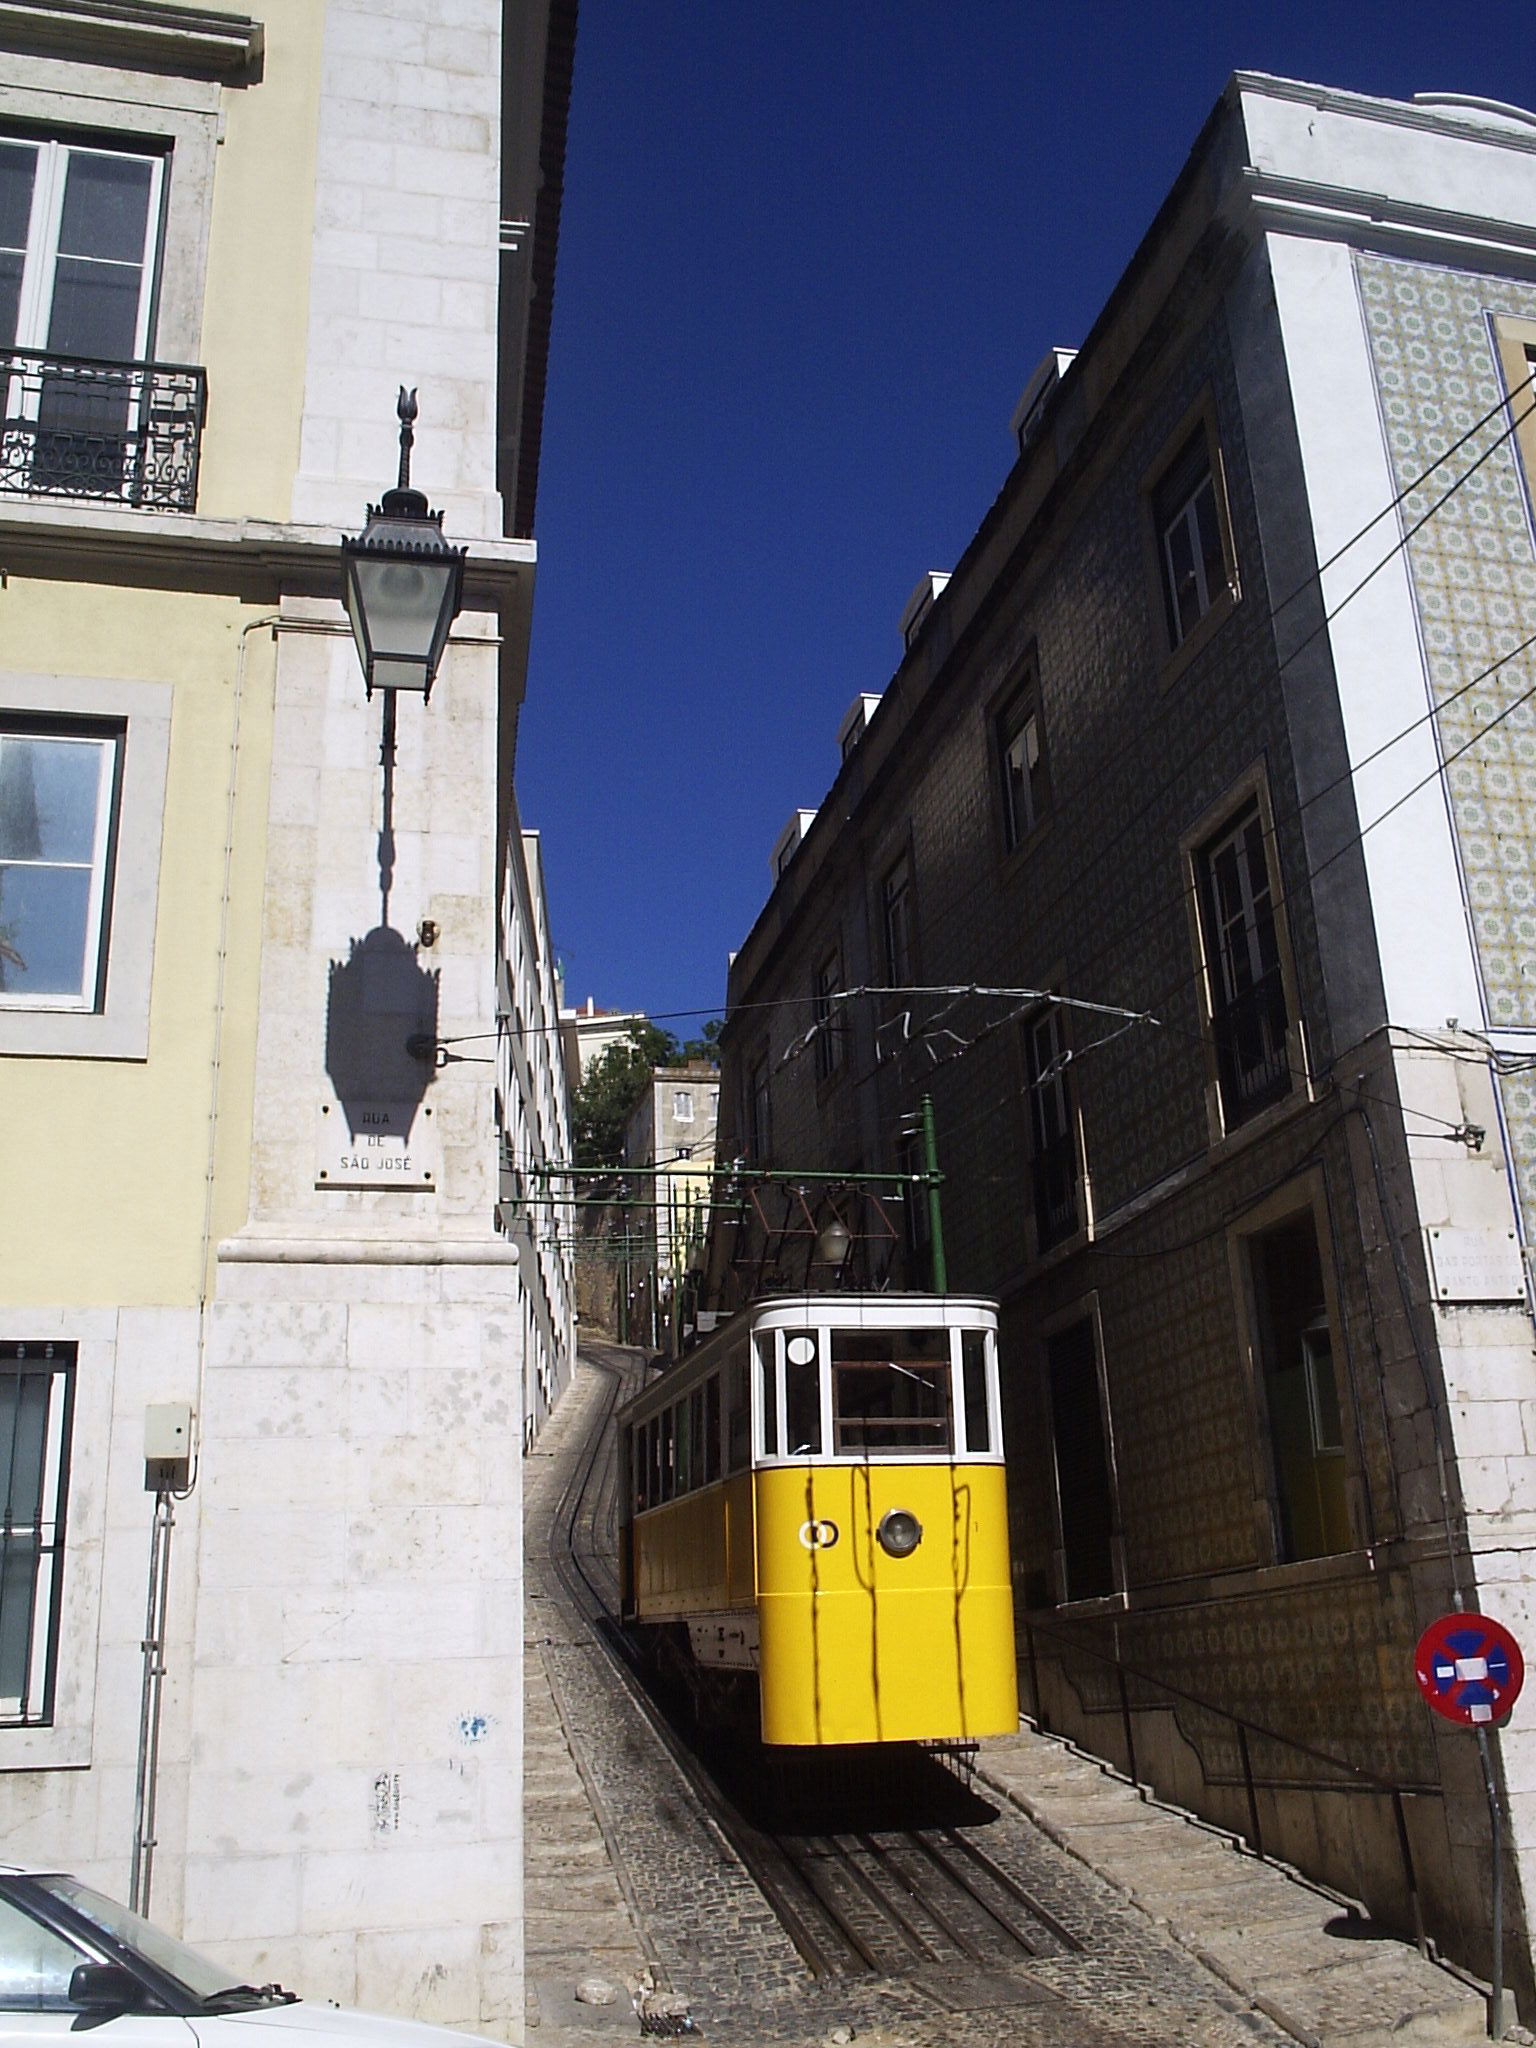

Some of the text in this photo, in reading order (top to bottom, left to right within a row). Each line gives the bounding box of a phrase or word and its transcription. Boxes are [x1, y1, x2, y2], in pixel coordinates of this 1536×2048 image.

[362, 1112, 389, 1124] RUA
[367, 1135, 385, 1147] DE
[340, 1154, 411, 1170] SÃO JOSÉ
